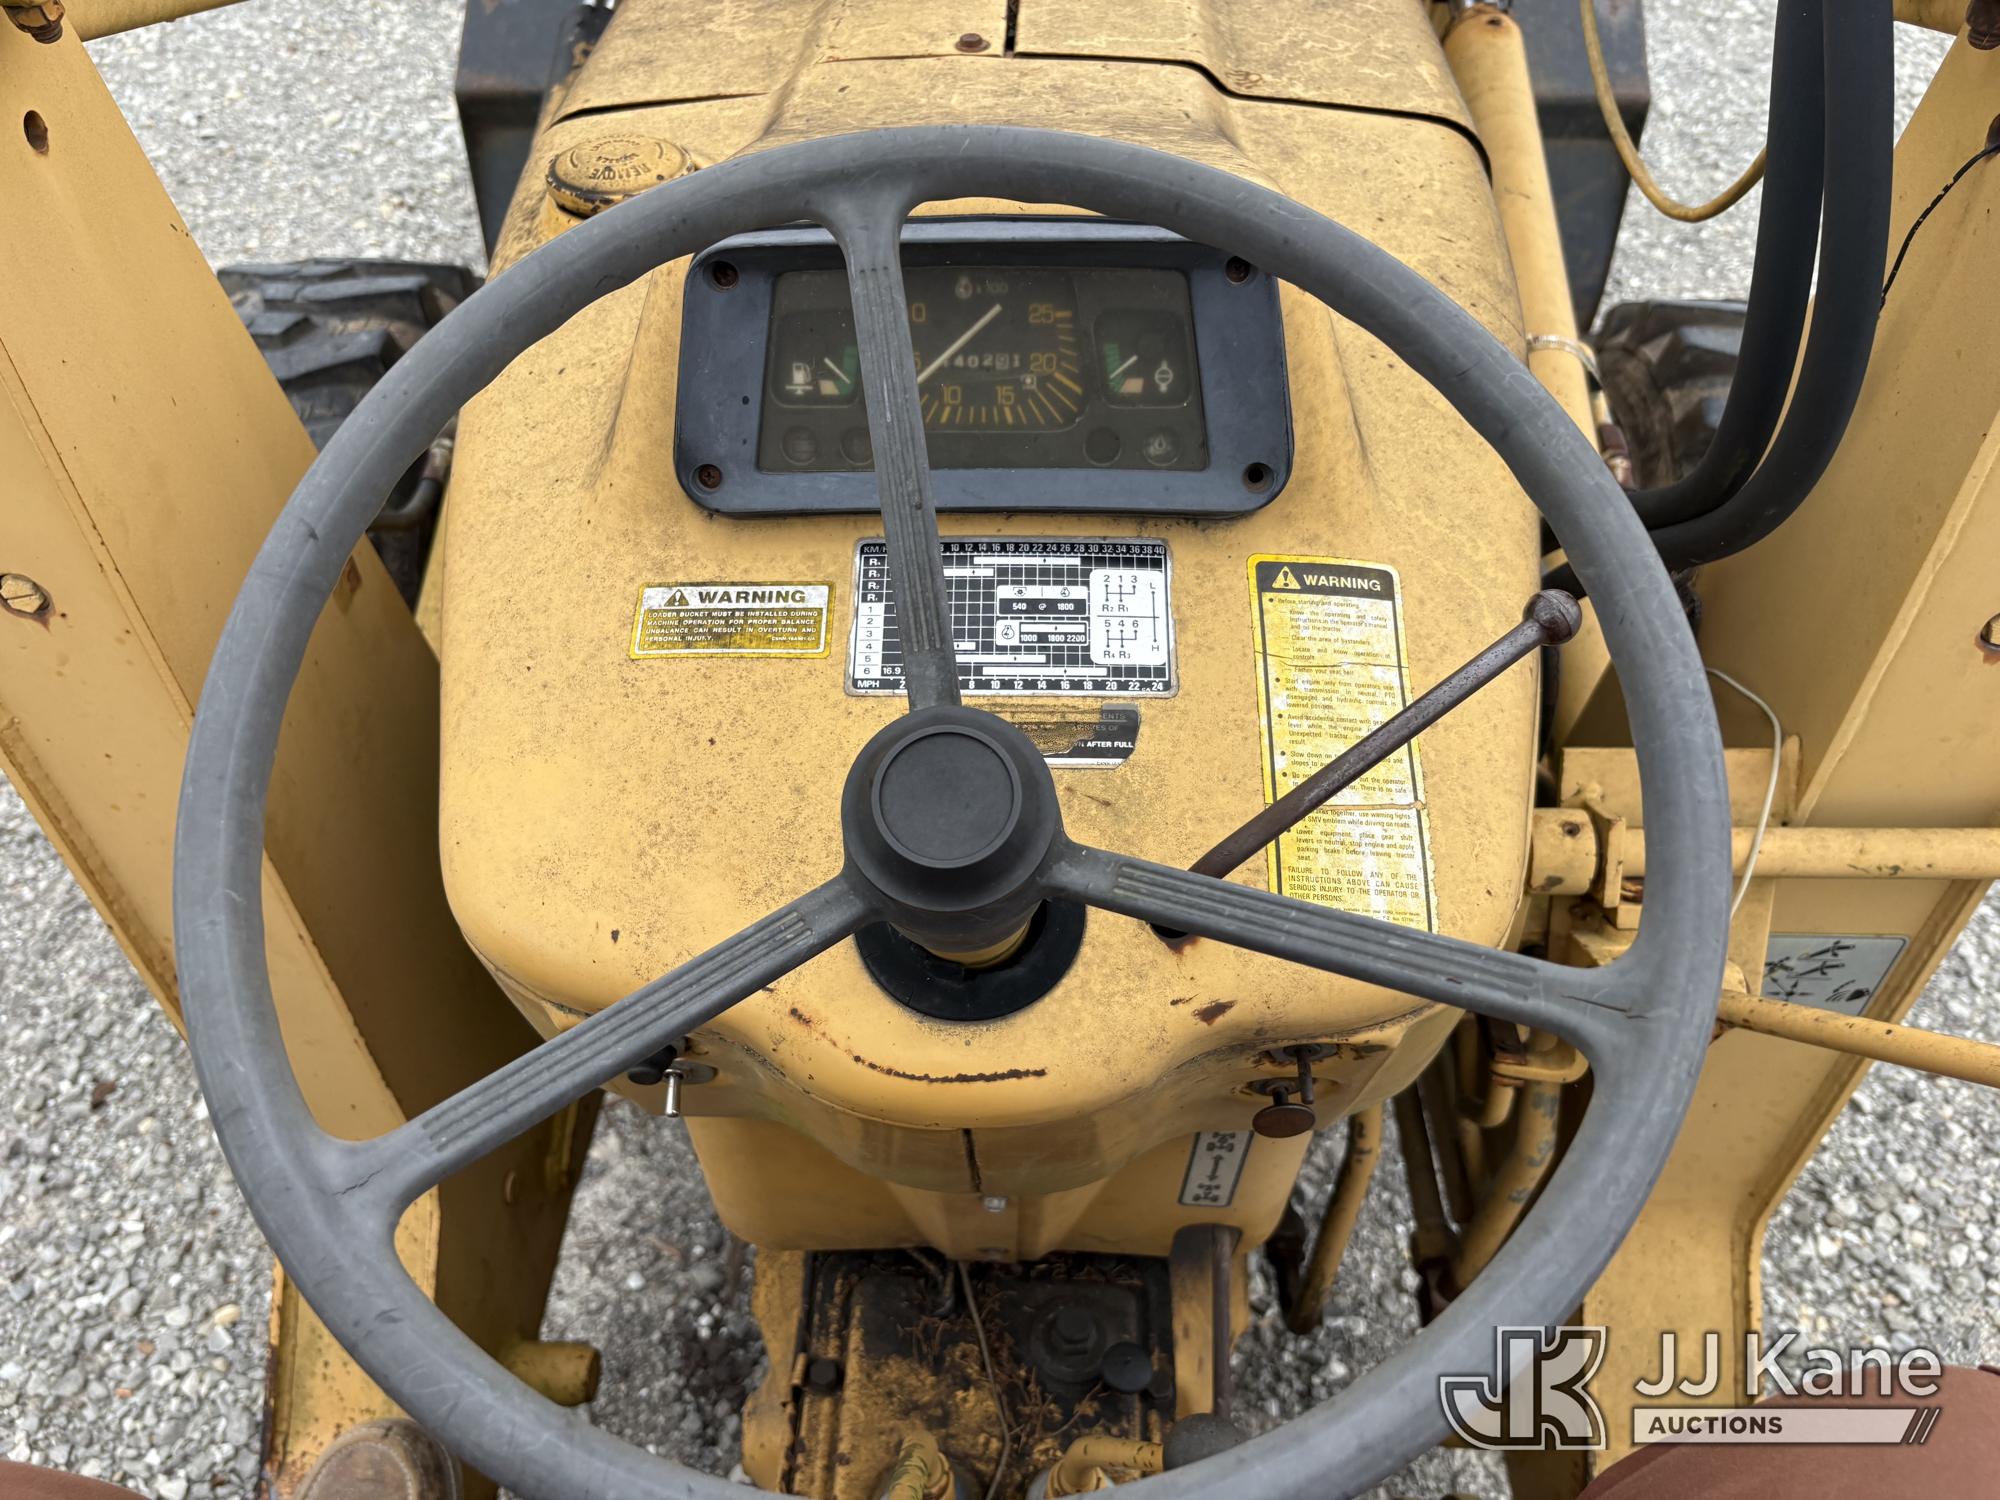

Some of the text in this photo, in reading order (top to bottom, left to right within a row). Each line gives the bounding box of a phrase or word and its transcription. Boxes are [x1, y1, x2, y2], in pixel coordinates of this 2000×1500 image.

[912, 303, 926, 322] 0
[1029, 304, 1054, 324] 25
[1030, 353, 1056, 372] 20
[943, 386, 961, 404] 10
[996, 385, 1014, 405] 15
[1006, 543, 1014, 551] 18
[1019, 543, 1029, 552] 20
[1032, 544, 1043, 552] 22
[1046, 544, 1057, 552] 24
[1060, 544, 1070, 552] 26
[1074, 544, 1084, 552] 28
[1088, 544, 1098, 552] 30
[1102, 544, 1112, 552] 32
[1116, 545, 1126, 553] 34
[1129, 545, 1140, 553] 36
[1142, 545, 1152, 553] 38
[1154, 546, 1164, 554] 40
[1131, 575, 1138, 583] 3
[1303, 574, 1381, 591] WARNING
[698, 590, 806, 604] WARNING
[882, 667, 900, 675] 16.9
[857, 680, 879, 688] MPH
[969, 680, 975, 689] 8
[1106, 682, 1117, 690] 20
[1128, 682, 1140, 690] 22
[1152, 682, 1163, 690] 24
[1288, 875, 1342, 884] INSTRUCTIONS
[1375, 889, 1407, 897] OPERATOR
